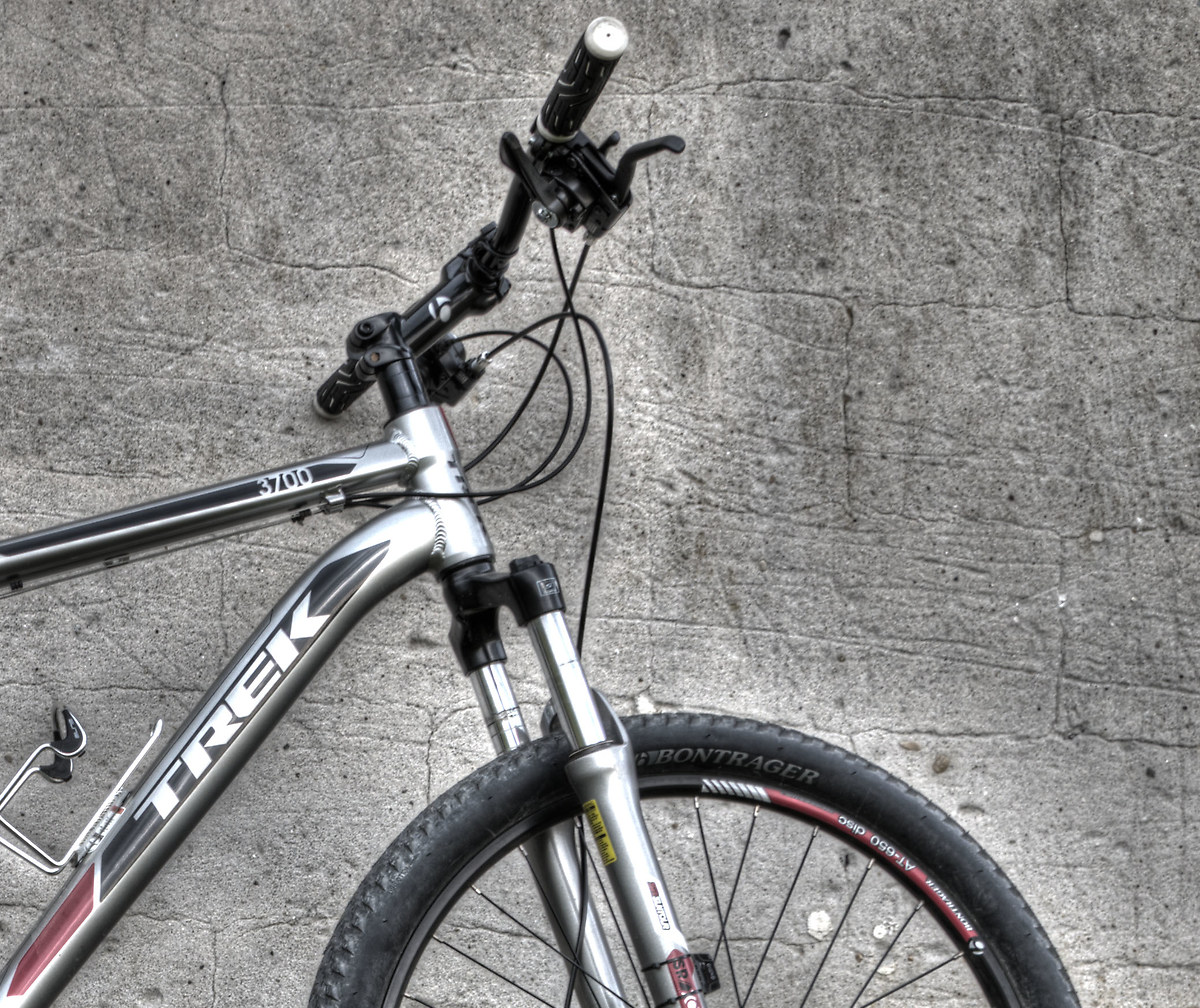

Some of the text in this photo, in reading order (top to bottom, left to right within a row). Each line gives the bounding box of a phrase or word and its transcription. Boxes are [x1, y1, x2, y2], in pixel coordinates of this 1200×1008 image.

[257, 467, 314, 496] 3700
[133, 590, 331, 820] TREK
[655, 748, 821, 785] BONTRAGER
[837, 815, 974, 931] BONTRAGER AT-650 disc
